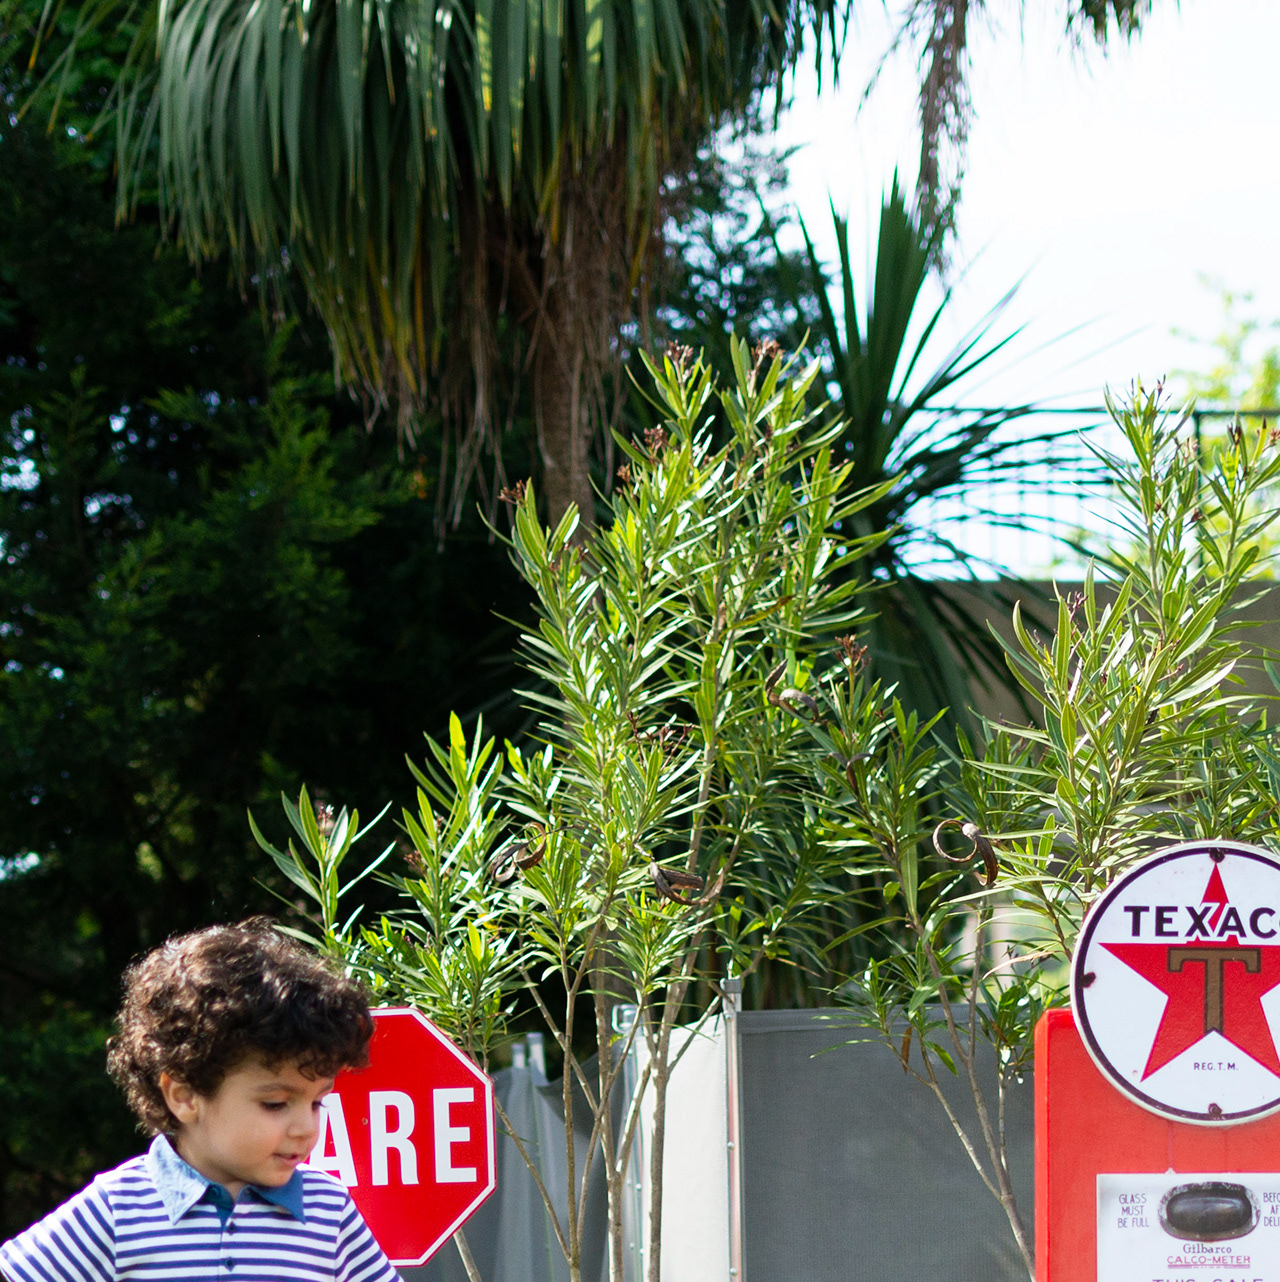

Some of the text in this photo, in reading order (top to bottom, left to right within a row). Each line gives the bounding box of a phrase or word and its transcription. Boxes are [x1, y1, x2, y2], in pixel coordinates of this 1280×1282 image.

[307, 1087, 477, 1188] ARE
[1118, 1193, 1147, 1204] GLASS
[1121, 1205, 1144, 1216] MUST
[1118, 1217, 1150, 1228] BE FULL
[1182, 1243, 1232, 1254] Gilbarco
[1166, 1255, 1251, 1265] CALCO-METER
